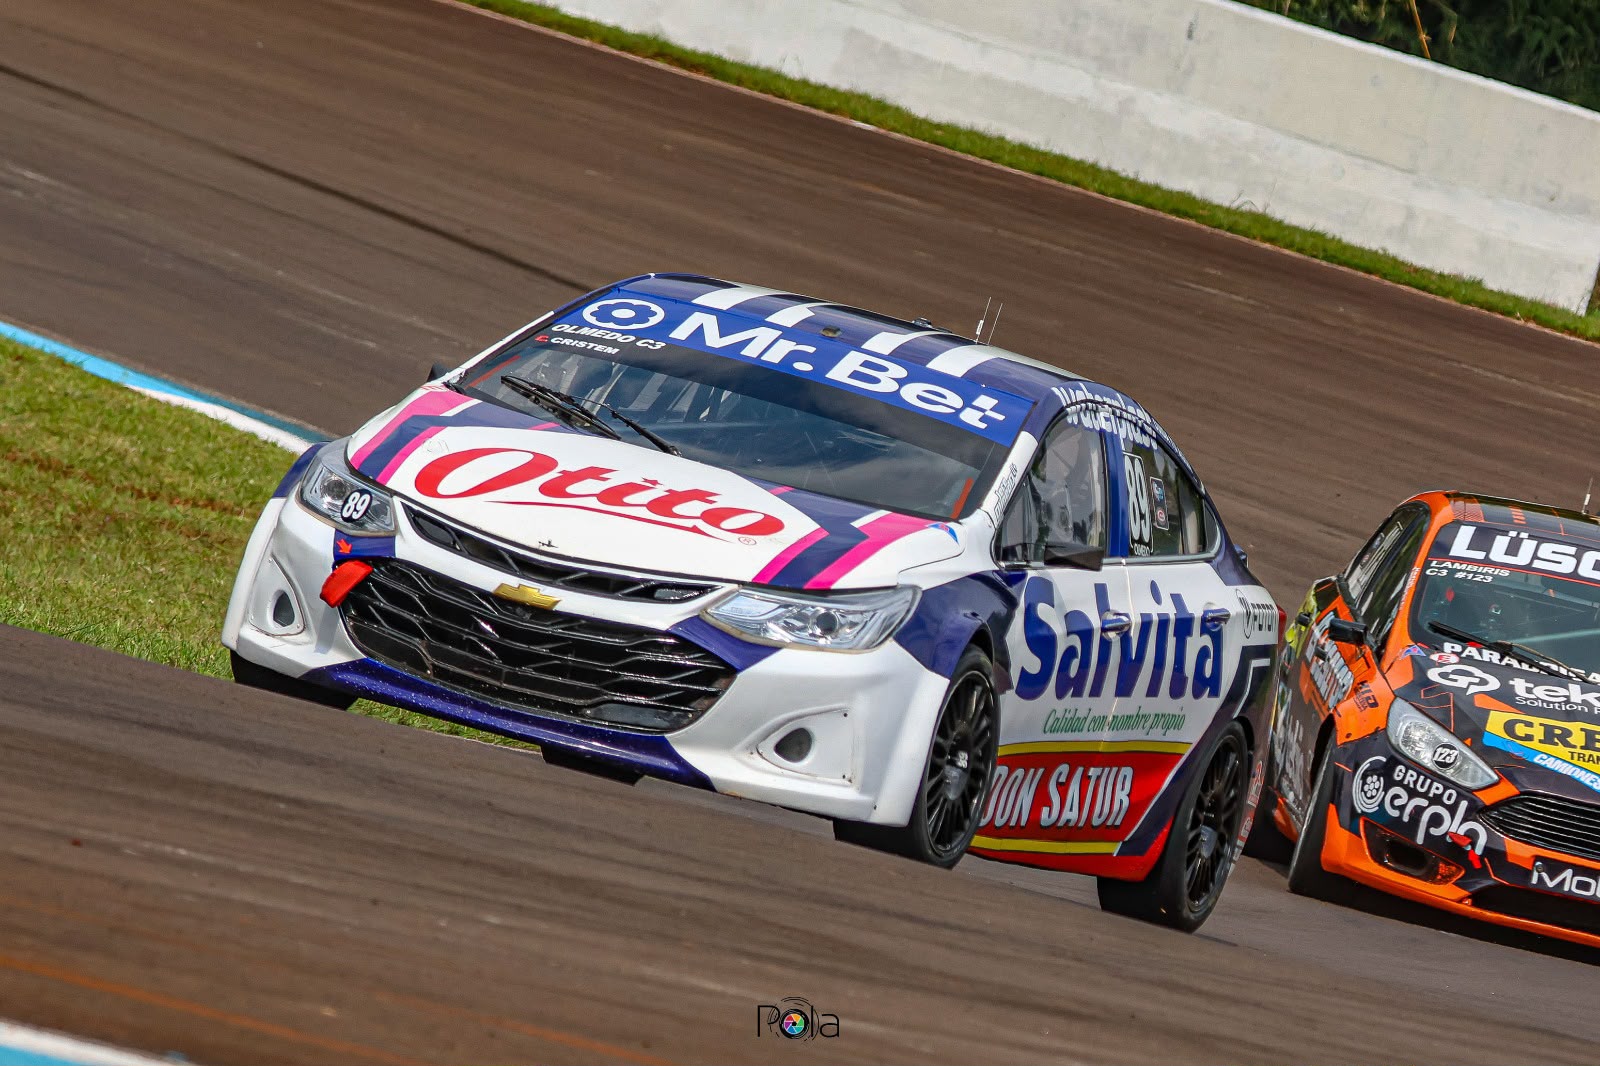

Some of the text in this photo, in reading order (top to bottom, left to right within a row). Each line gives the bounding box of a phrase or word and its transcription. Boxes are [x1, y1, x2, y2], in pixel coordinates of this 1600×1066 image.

[550, 337, 620, 355] CRISTEM
[552, 324, 666, 350] OLMEDO C3
[668, 311, 1006, 429] Mr. Bet
[342, 491, 371, 520] 89
[414, 447, 785, 537] Otito
[1124, 455, 1151, 543] 89
[1425, 568, 1493, 583] C3 #123
[1430, 560, 1511, 577] LAMBIRIS
[1015, 576, 1224, 701] Salvita
[1515, 697, 1589, 713] Solution
[1043, 706, 1186, 736] Calidad con nombre propio
[1433, 747, 1459, 763] 123
[1040, 763, 1133, 829] SATUR
[1393, 765, 1457, 804] GRUPO
[1531, 861, 1600, 898] Mo
